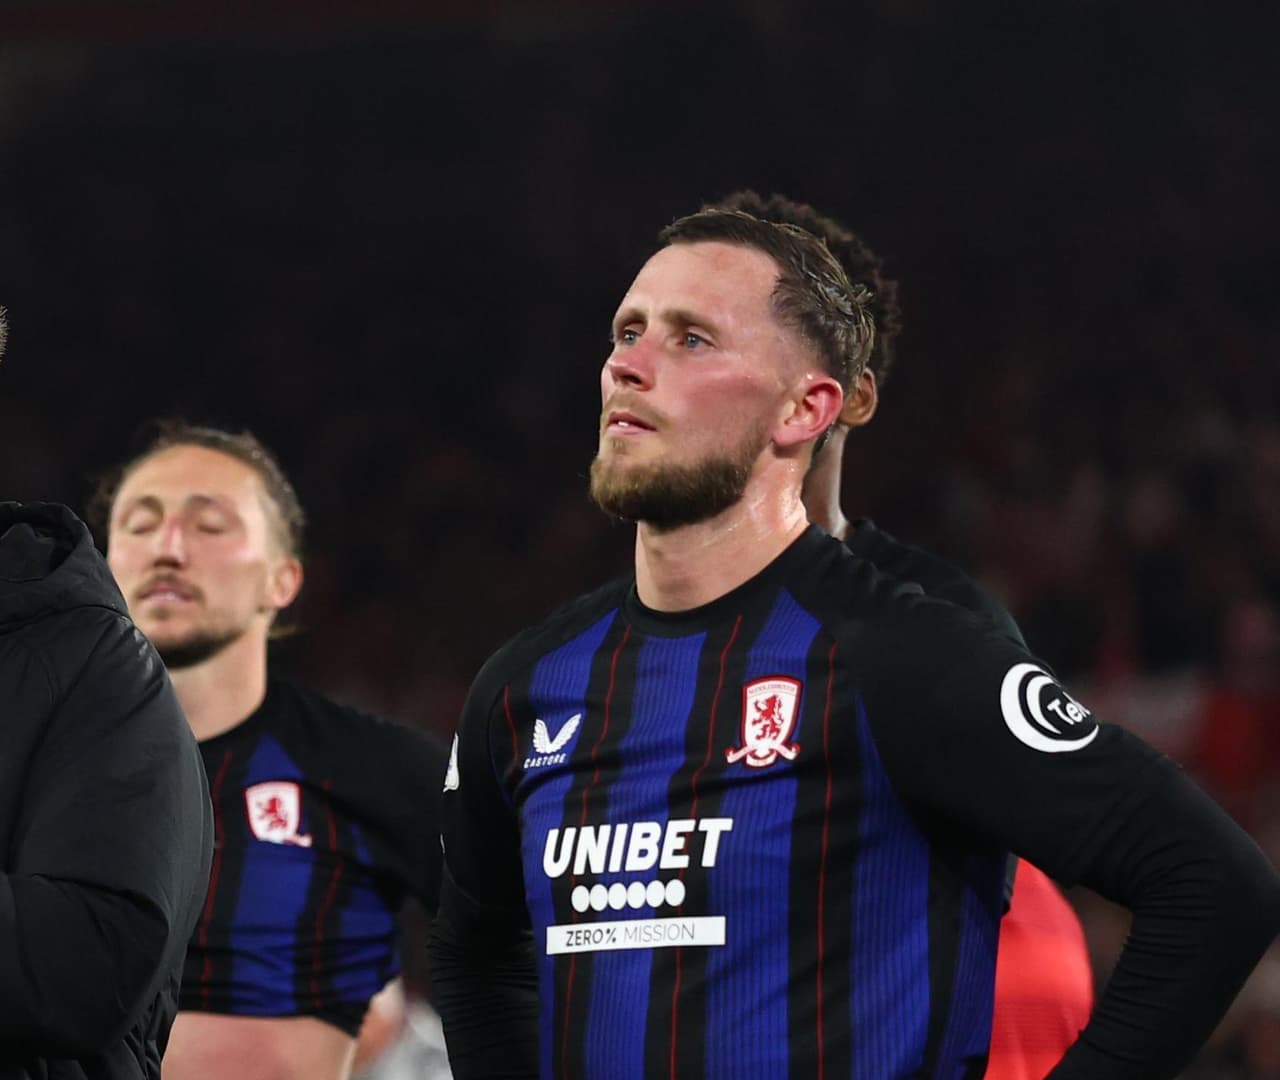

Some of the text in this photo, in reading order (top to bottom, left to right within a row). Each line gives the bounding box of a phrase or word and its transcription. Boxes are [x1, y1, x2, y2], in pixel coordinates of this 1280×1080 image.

[523, 752, 567, 769] CASTORE
[542, 818, 734, 879] UNIBET
[566, 922, 695, 947] ZERO% MISSION
